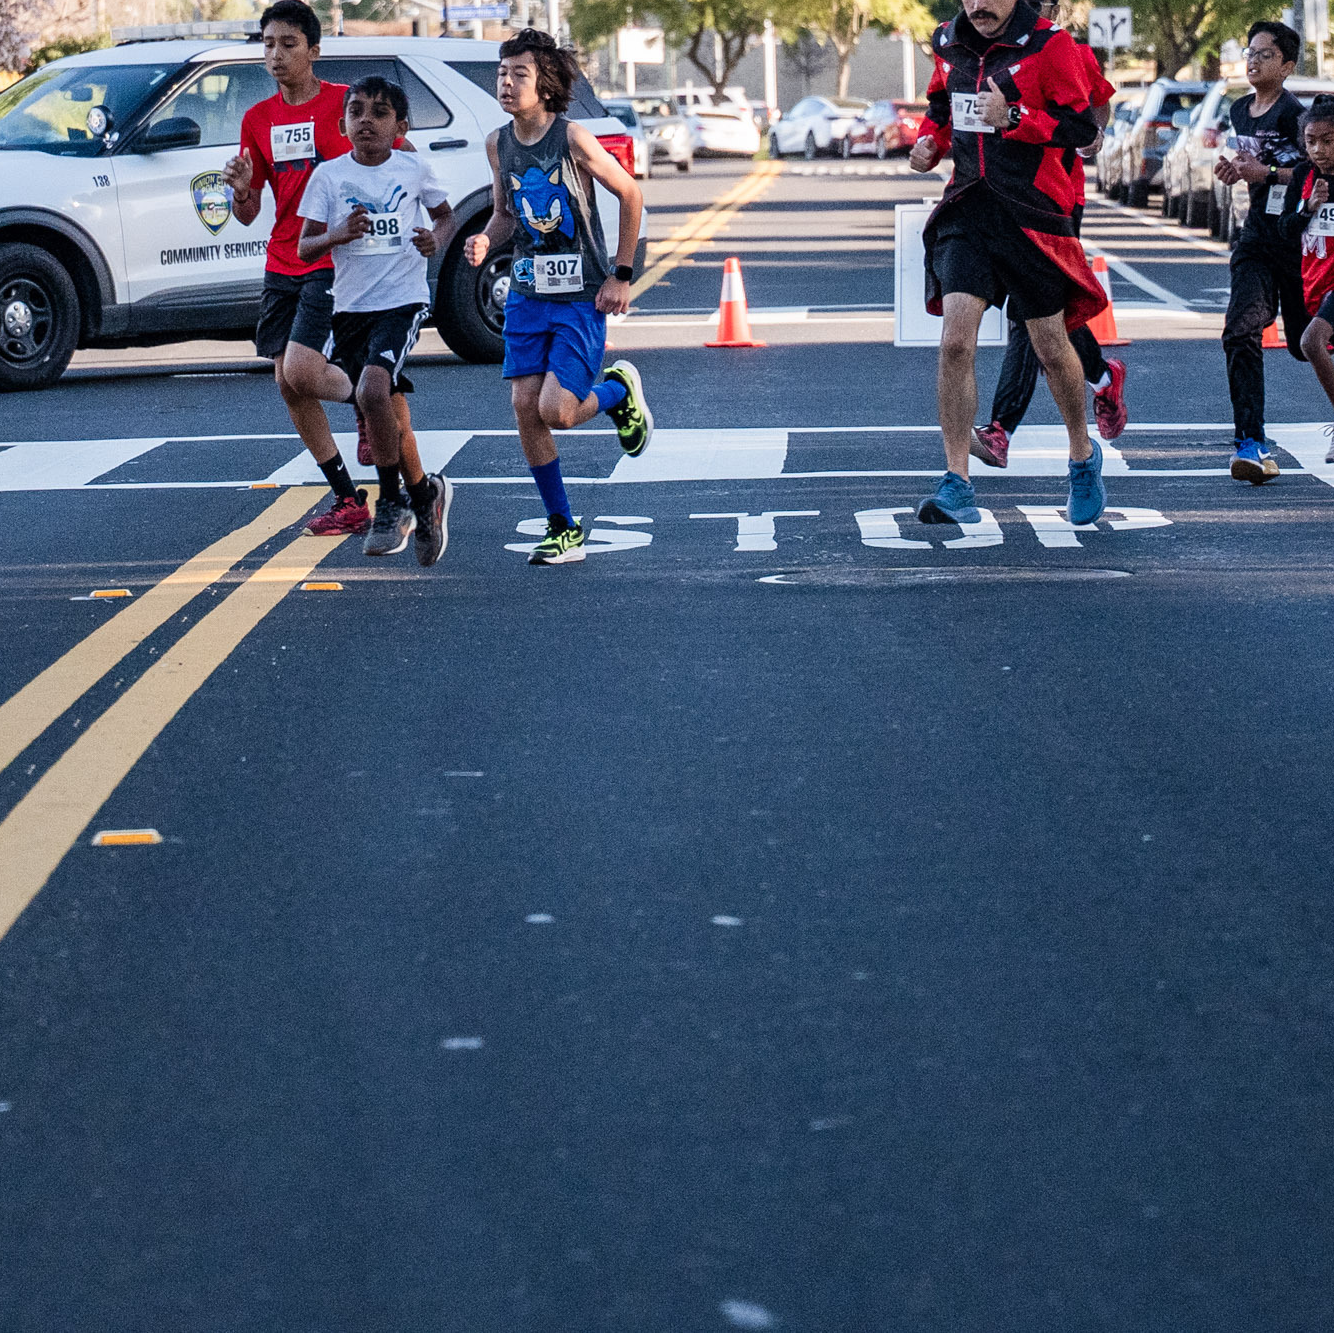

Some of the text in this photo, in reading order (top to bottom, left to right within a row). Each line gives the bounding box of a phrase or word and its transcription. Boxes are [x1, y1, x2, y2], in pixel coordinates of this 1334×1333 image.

[284, 127, 311, 144] 755
[92, 174, 111, 188] 138
[367, 218, 400, 237] 498
[160, 239, 268, 266] COMMUNITY SERVICES
[546, 259, 579, 276] 307
[503, 504, 1175, 555] STOP
